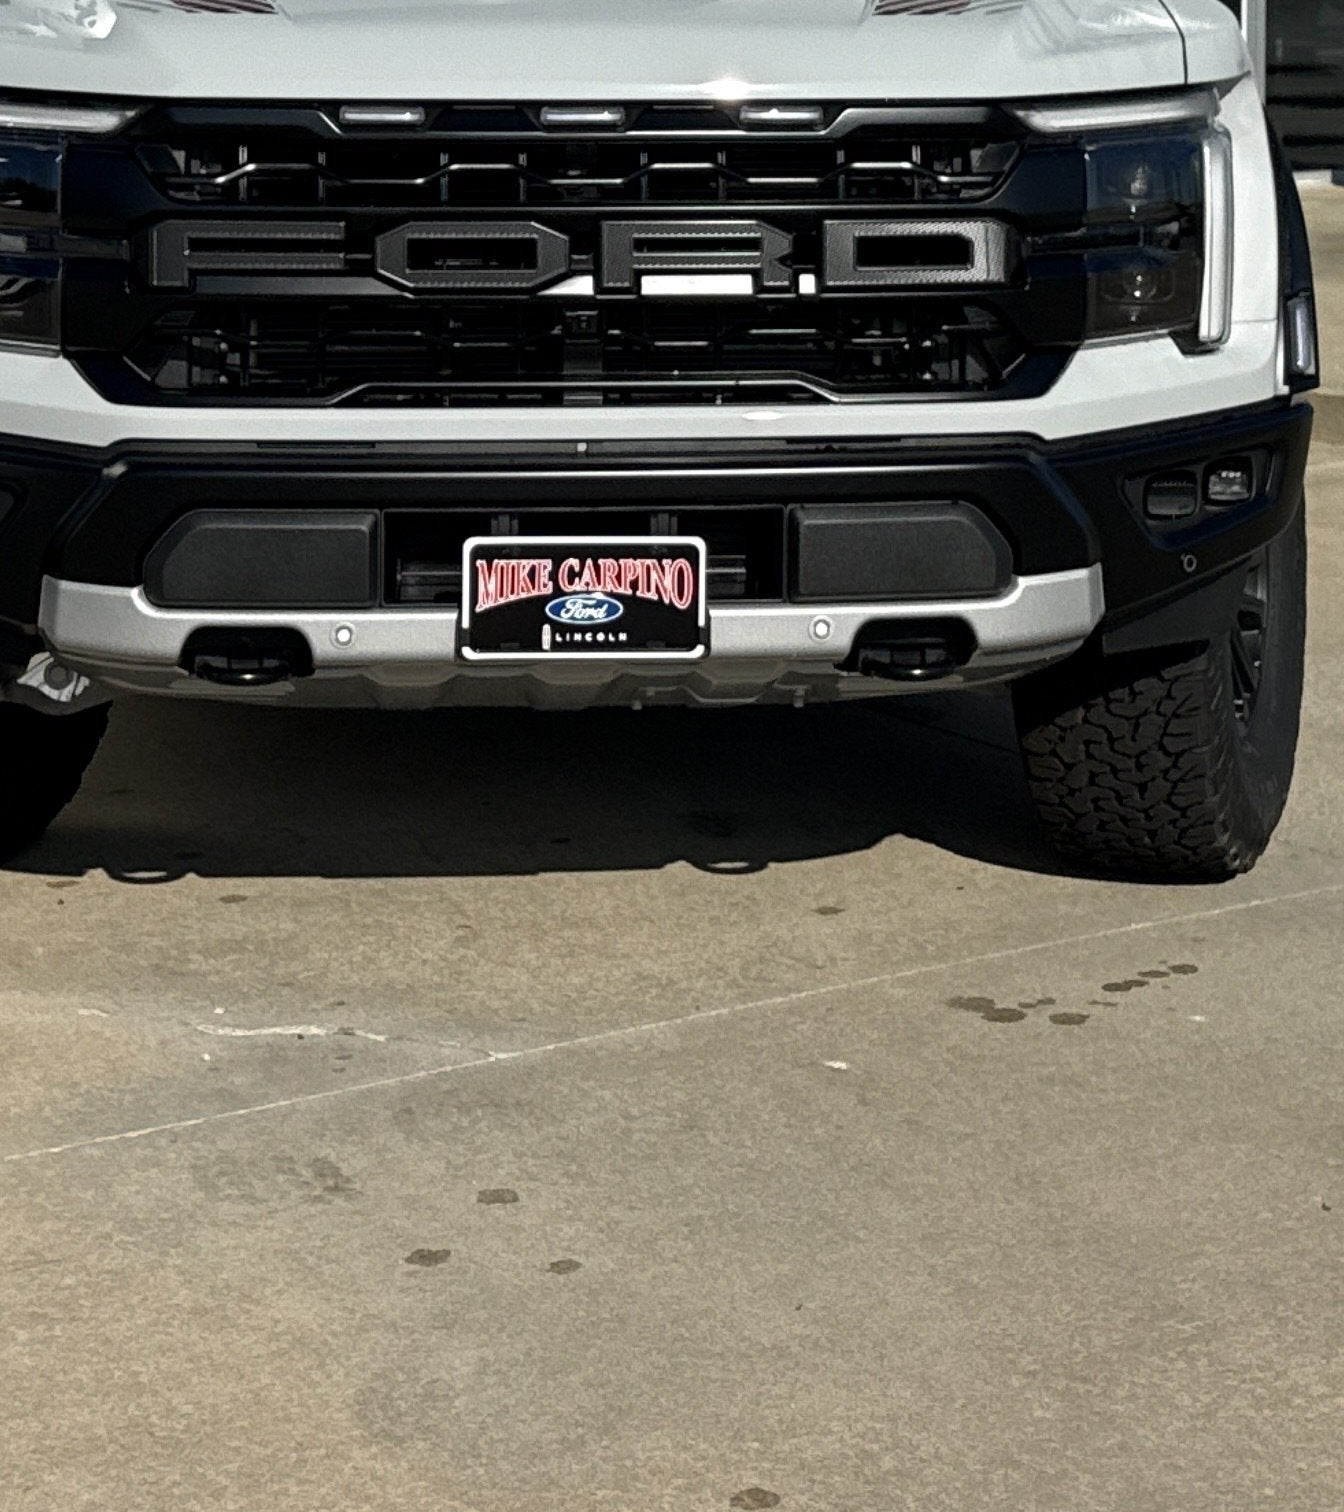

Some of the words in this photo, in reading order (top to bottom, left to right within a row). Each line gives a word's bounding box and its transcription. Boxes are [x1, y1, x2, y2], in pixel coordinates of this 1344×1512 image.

[150, 218, 1026, 290] FORD
[475, 558, 553, 612] MIKE
[557, 557, 694, 610] CARPINO
[559, 598, 609, 620] Ford
[555, 631, 628, 643] LINCOLN
